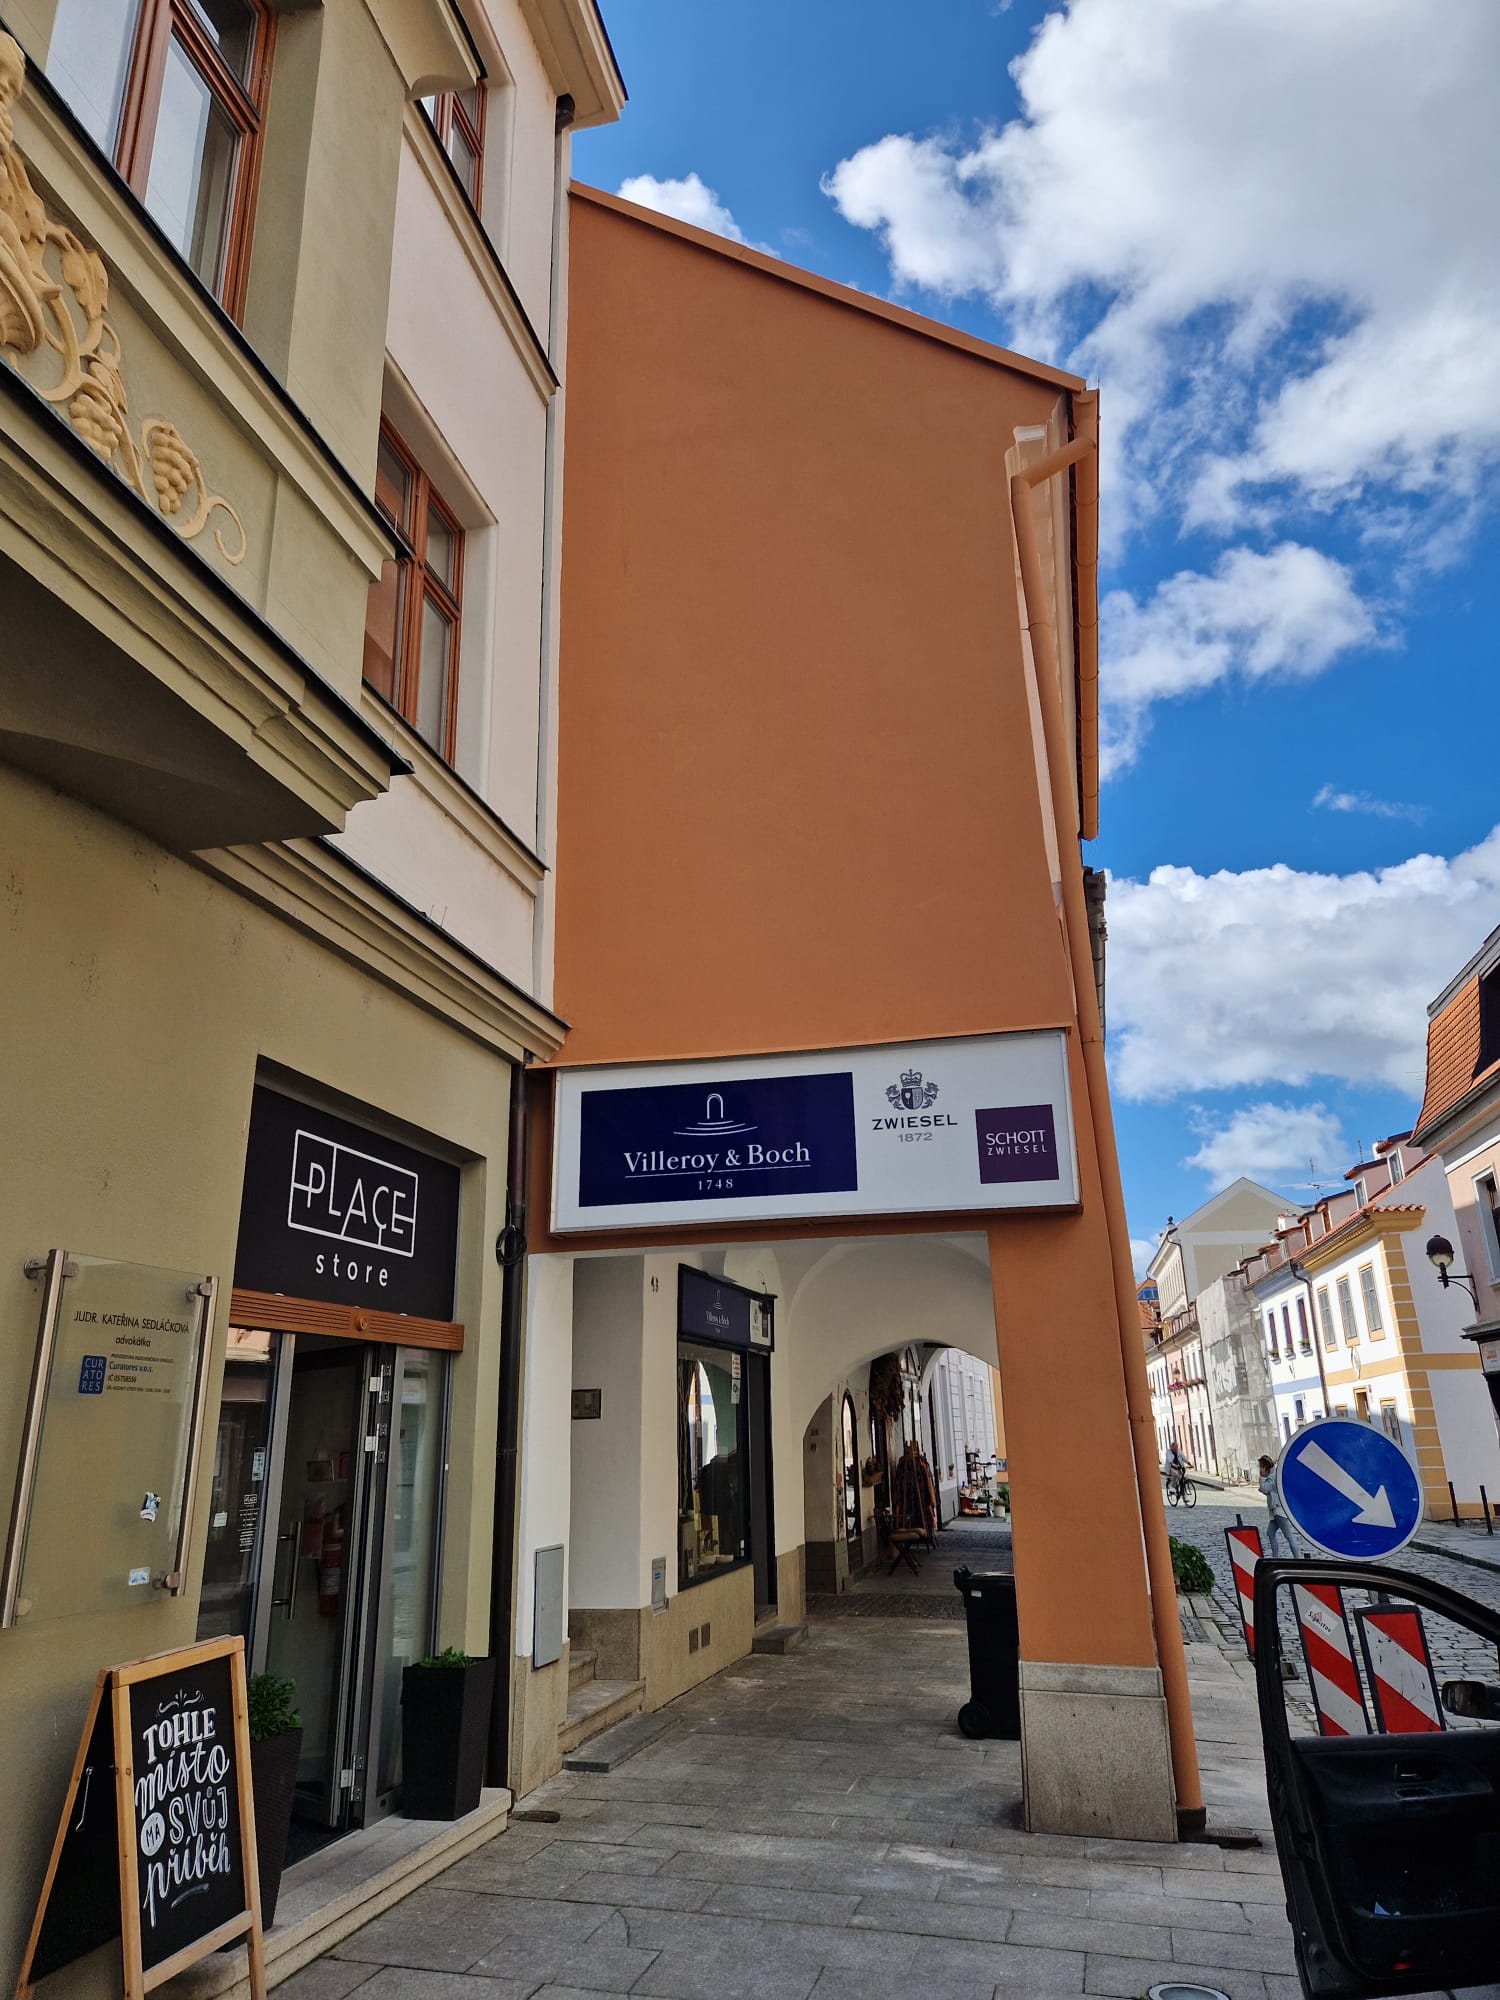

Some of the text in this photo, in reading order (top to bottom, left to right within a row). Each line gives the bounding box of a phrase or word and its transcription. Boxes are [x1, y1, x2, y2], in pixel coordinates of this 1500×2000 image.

[872, 1114, 958, 1131] ZWIESEL
[897, 1132, 933, 1143] 1872
[985, 1129, 1046, 1146] SCHOTT
[624, 1142, 810, 1173] Villeroy & Boch
[987, 1144, 1048, 1156] ZWIESEL
[698, 1178, 734, 1190] 1748
[301, 1146, 408, 1240] PLACE
[315, 1253, 389, 1287] store
[101, 1312, 140, 1329] KATEŘINA
[141, 1317, 190, 1334] SEDLÁČKOVÁ
[115, 1334, 151, 1347] advokátka
[84, 1357, 105, 1369] CUR
[109, 1360, 138, 1372] Curatores
[82, 1369, 103, 1380] ATO
[81, 1381, 101, 1392] RES
[143, 1707, 217, 1764] TOHLE
[145, 1814, 162, 1844] MÁ
[143, 1831, 231, 1930] příběh
